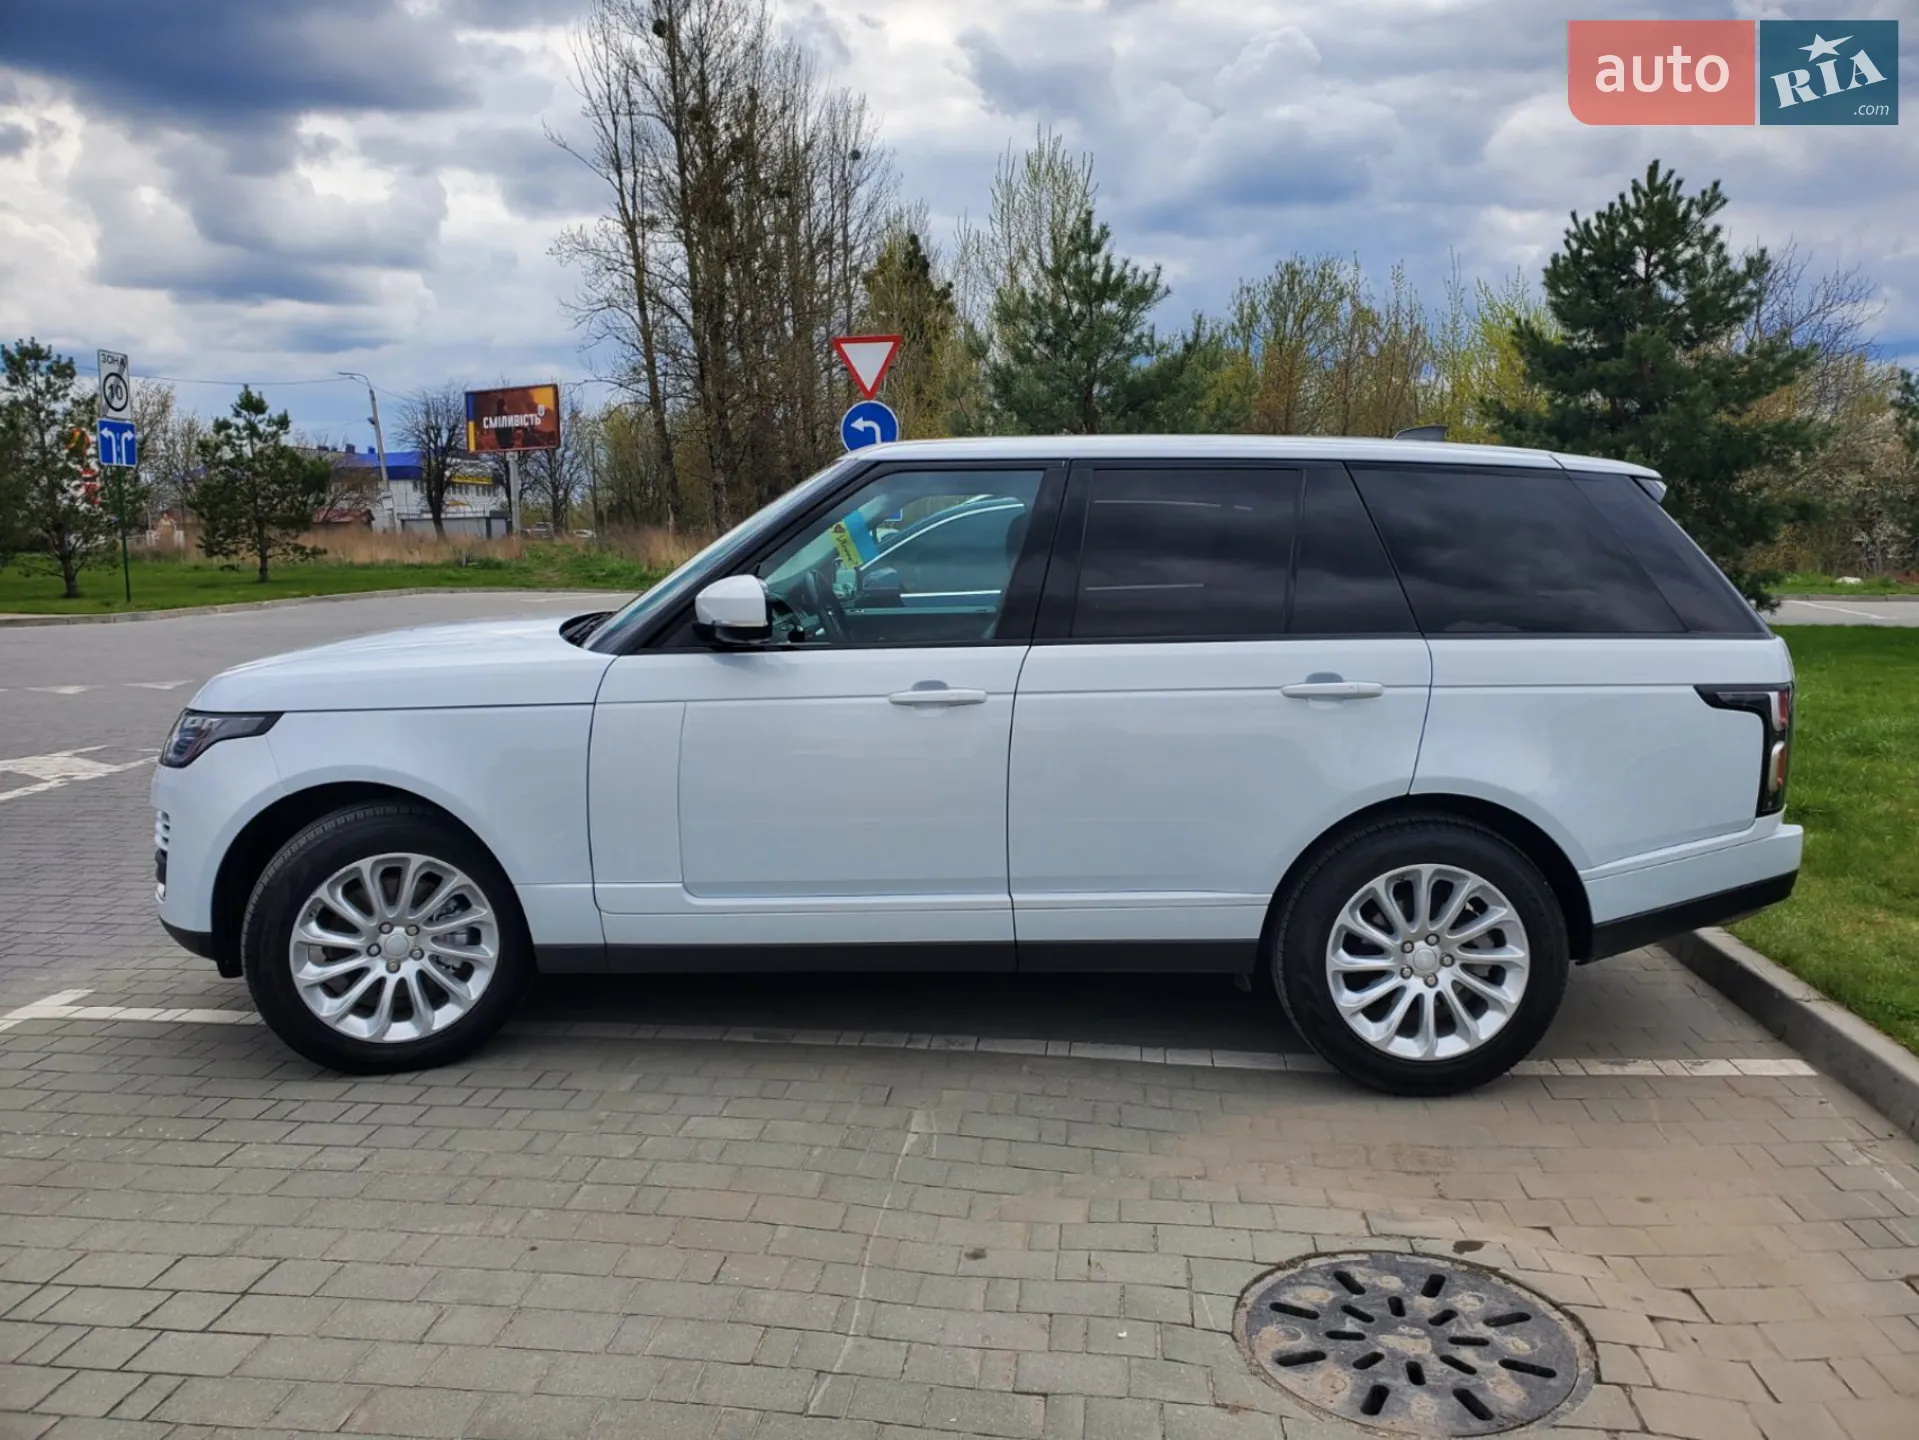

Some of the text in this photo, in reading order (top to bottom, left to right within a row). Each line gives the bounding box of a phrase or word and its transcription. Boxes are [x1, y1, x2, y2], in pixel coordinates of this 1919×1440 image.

[101, 353, 126, 368] ЗОНА
[108, 383, 124, 401] 10
[483, 413, 542, 429] СМІЛИВІСТЬ
